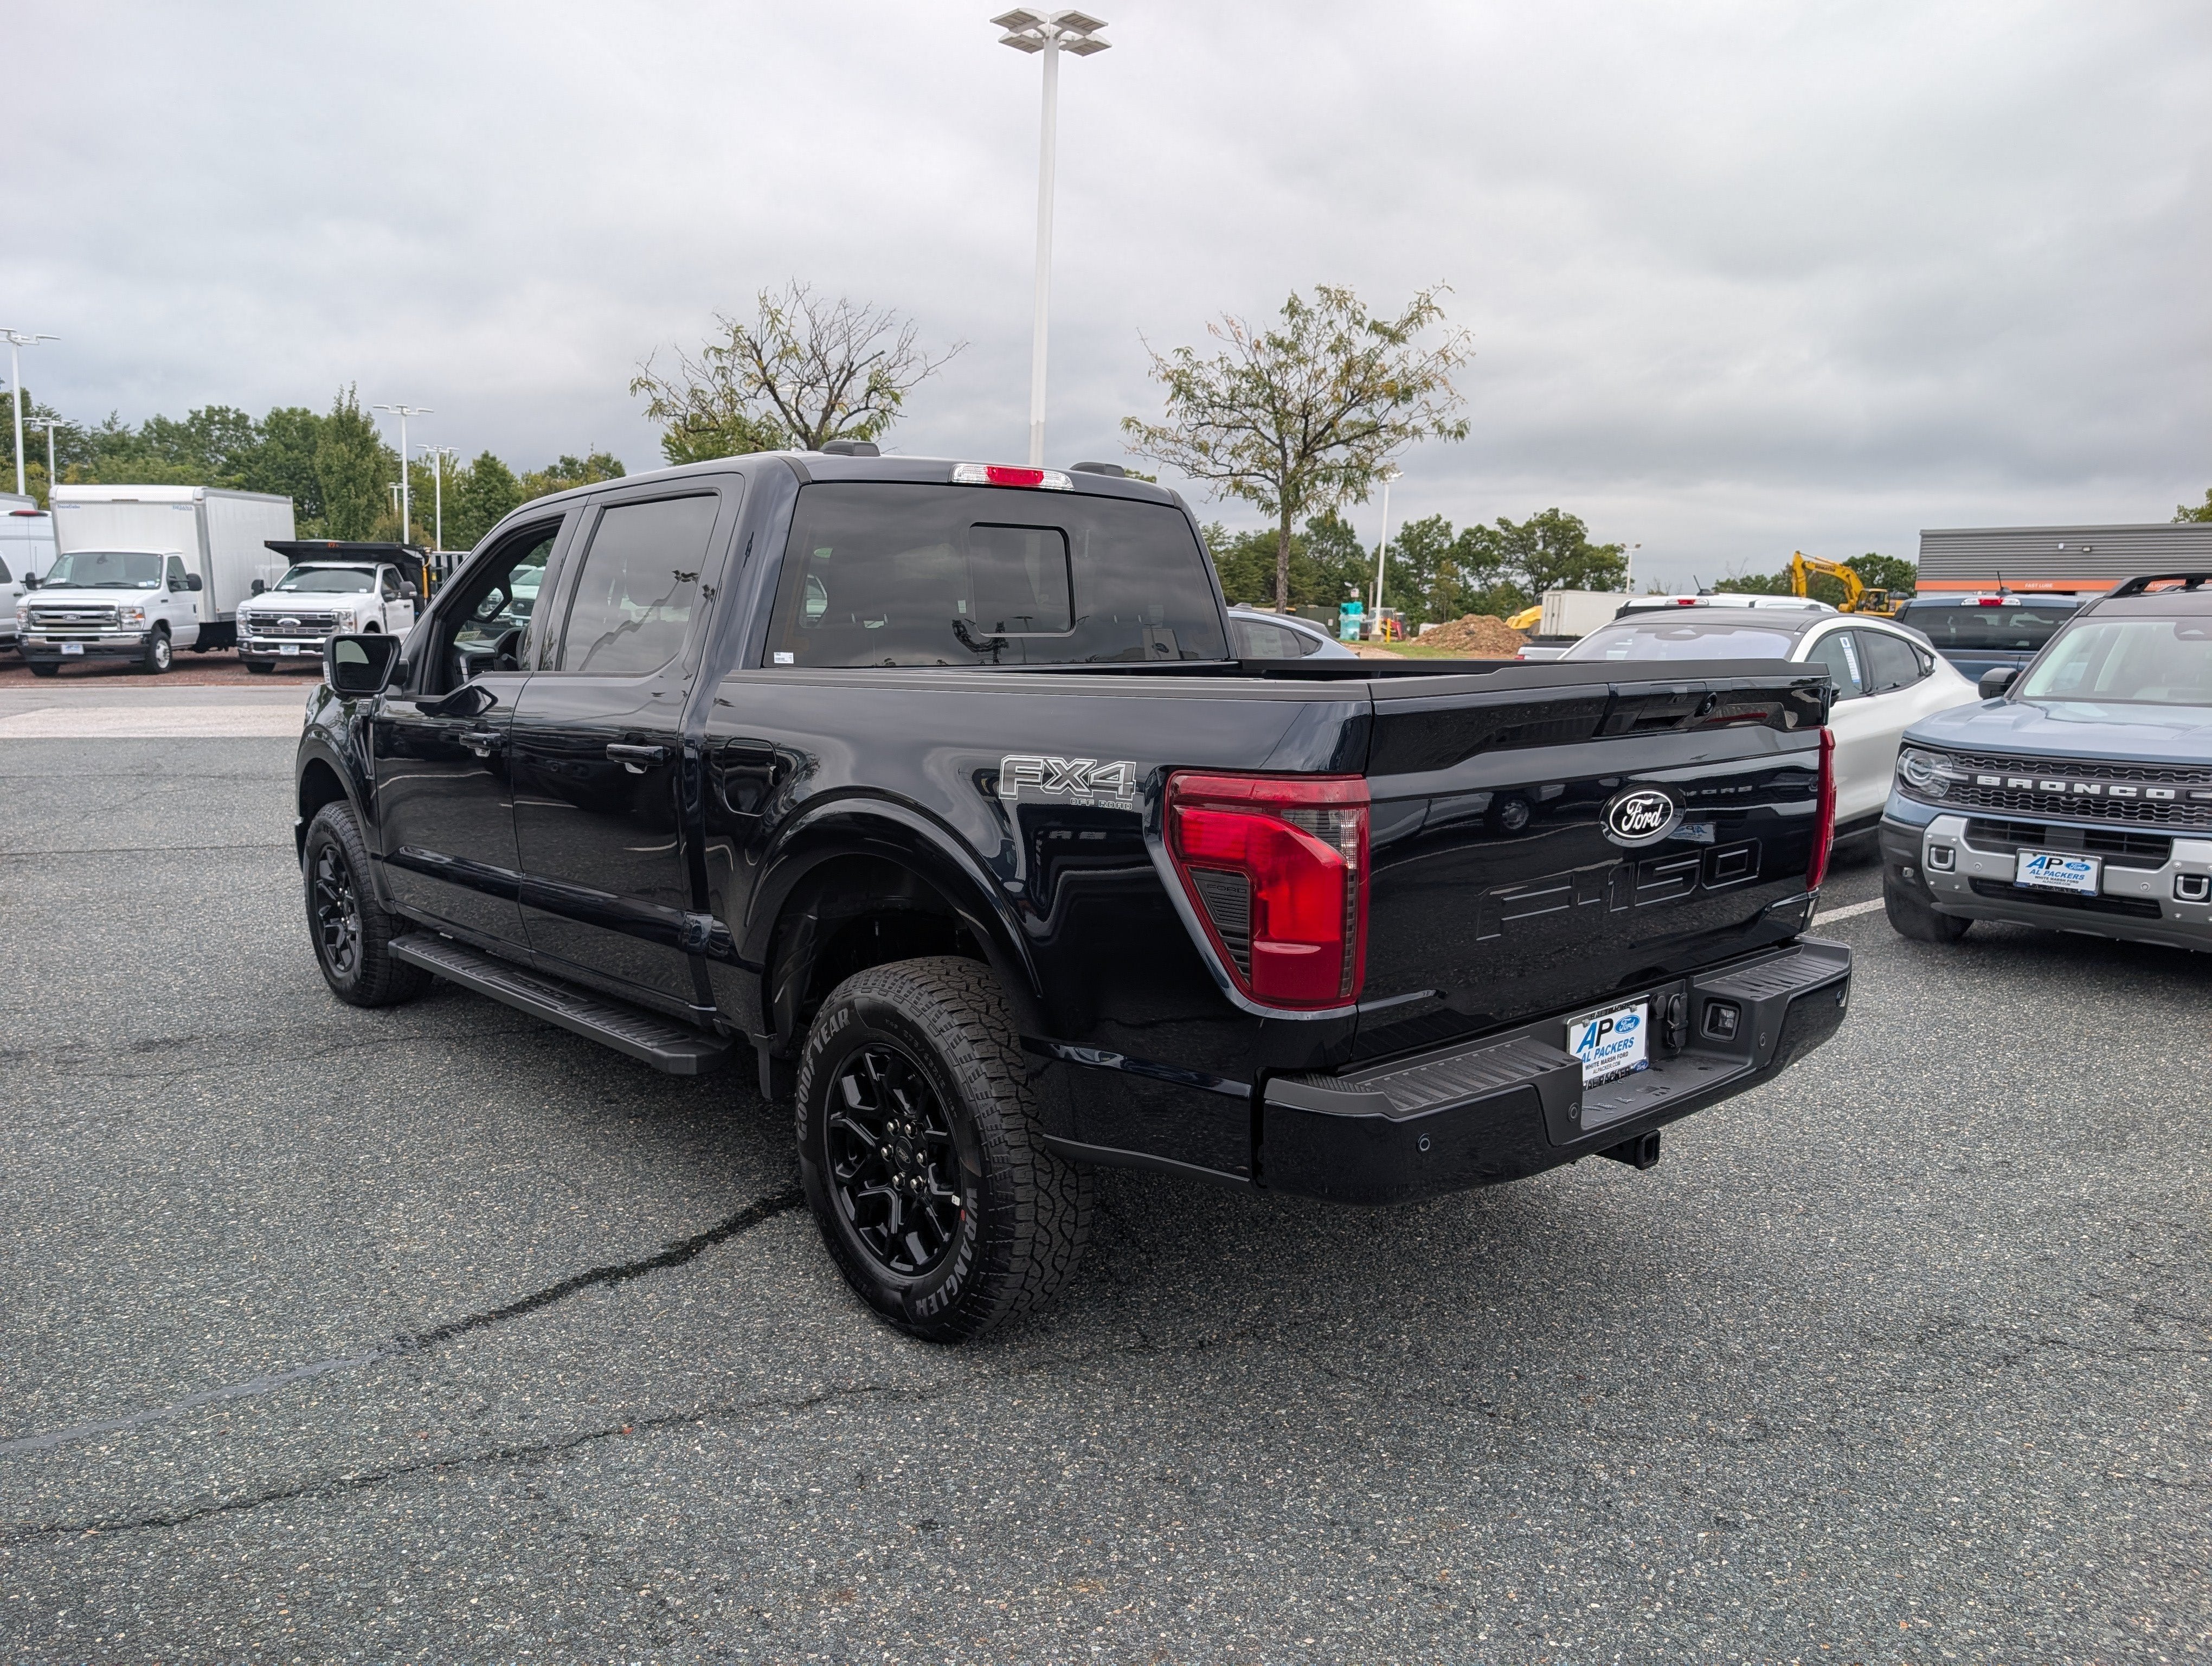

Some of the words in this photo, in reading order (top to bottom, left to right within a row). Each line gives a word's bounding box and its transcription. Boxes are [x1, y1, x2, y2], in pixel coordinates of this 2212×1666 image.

[999, 754, 1136, 800] FX4
[1977, 775, 2175, 799] BRONCO
[1098, 800, 1133, 810] ROAD
[1622, 798, 1663, 831] Ford
[2025, 855, 2063, 870] AP
[2043, 870, 2085, 880] PACKERS
[1207, 883, 1247, 894] FORD
[1476, 837, 1762, 940] F-150
[1576, 1018, 1614, 1054] AP
[1582, 1051, 1591, 1063] AL
[1593, 1037, 1635, 1060] PACKERS
[1585, 1061, 1600, 1071] WHITE
[1600, 1054, 1616, 1065] MARSH
[1617, 1051, 1629, 1060] FORD
[798, 1007, 851, 1141] GOODYEAR
[1592, 1061, 1621, 1074] ALPACKER.COM
[1599, 1067, 1630, 1085] PACKER
[915, 1188, 978, 1317] WRANGLER
